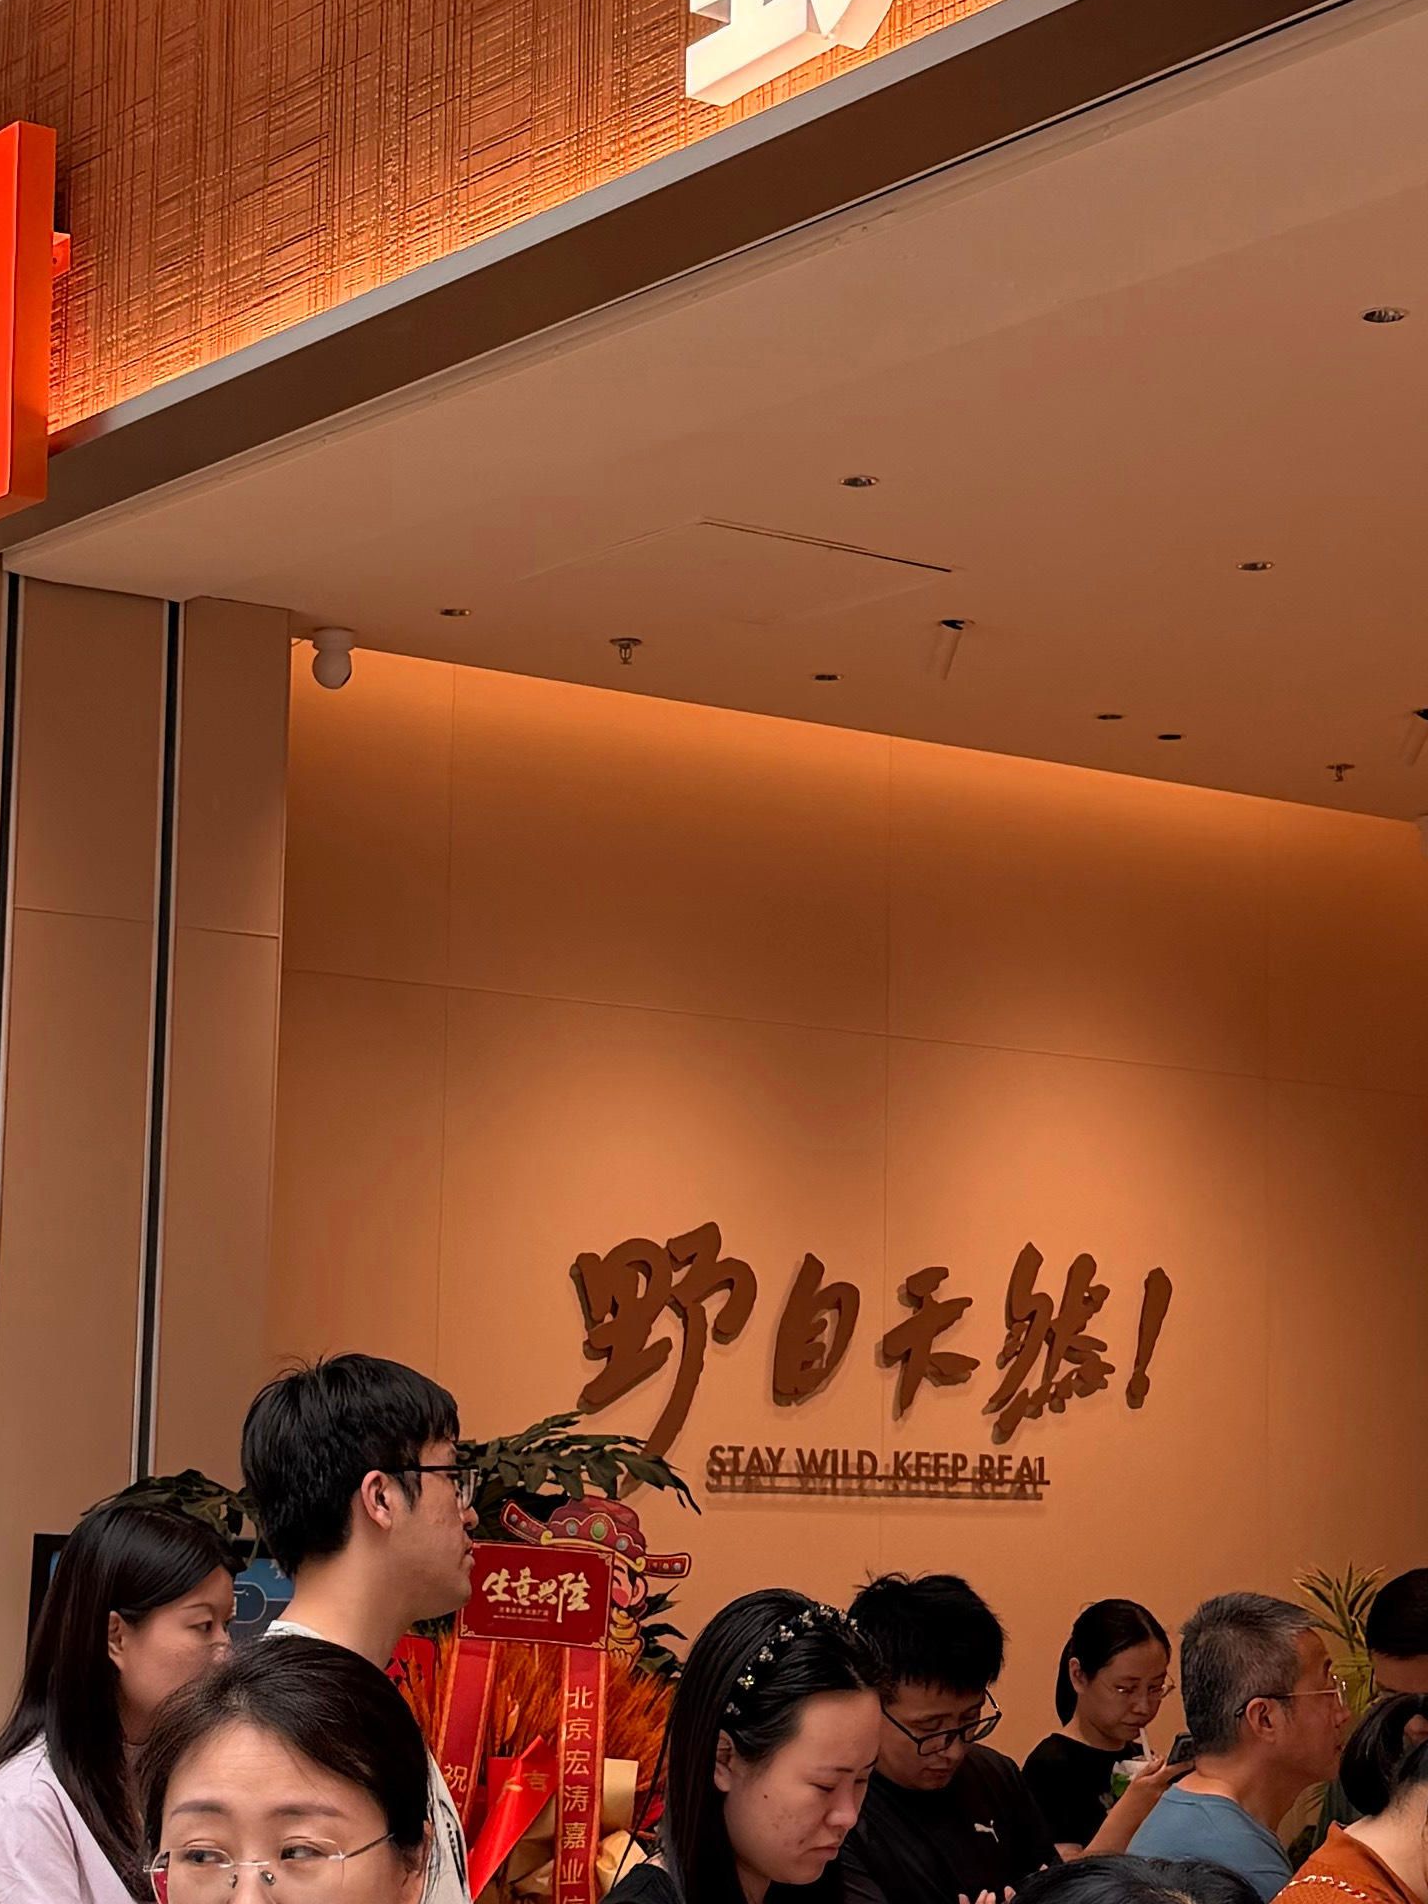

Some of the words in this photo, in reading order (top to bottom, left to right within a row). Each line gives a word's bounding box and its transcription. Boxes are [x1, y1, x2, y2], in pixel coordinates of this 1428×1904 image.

[708, 1444, 785, 1477] STAY
[892, 1449, 968, 1484] KEEP
[979, 1453, 1050, 1485] REAL
